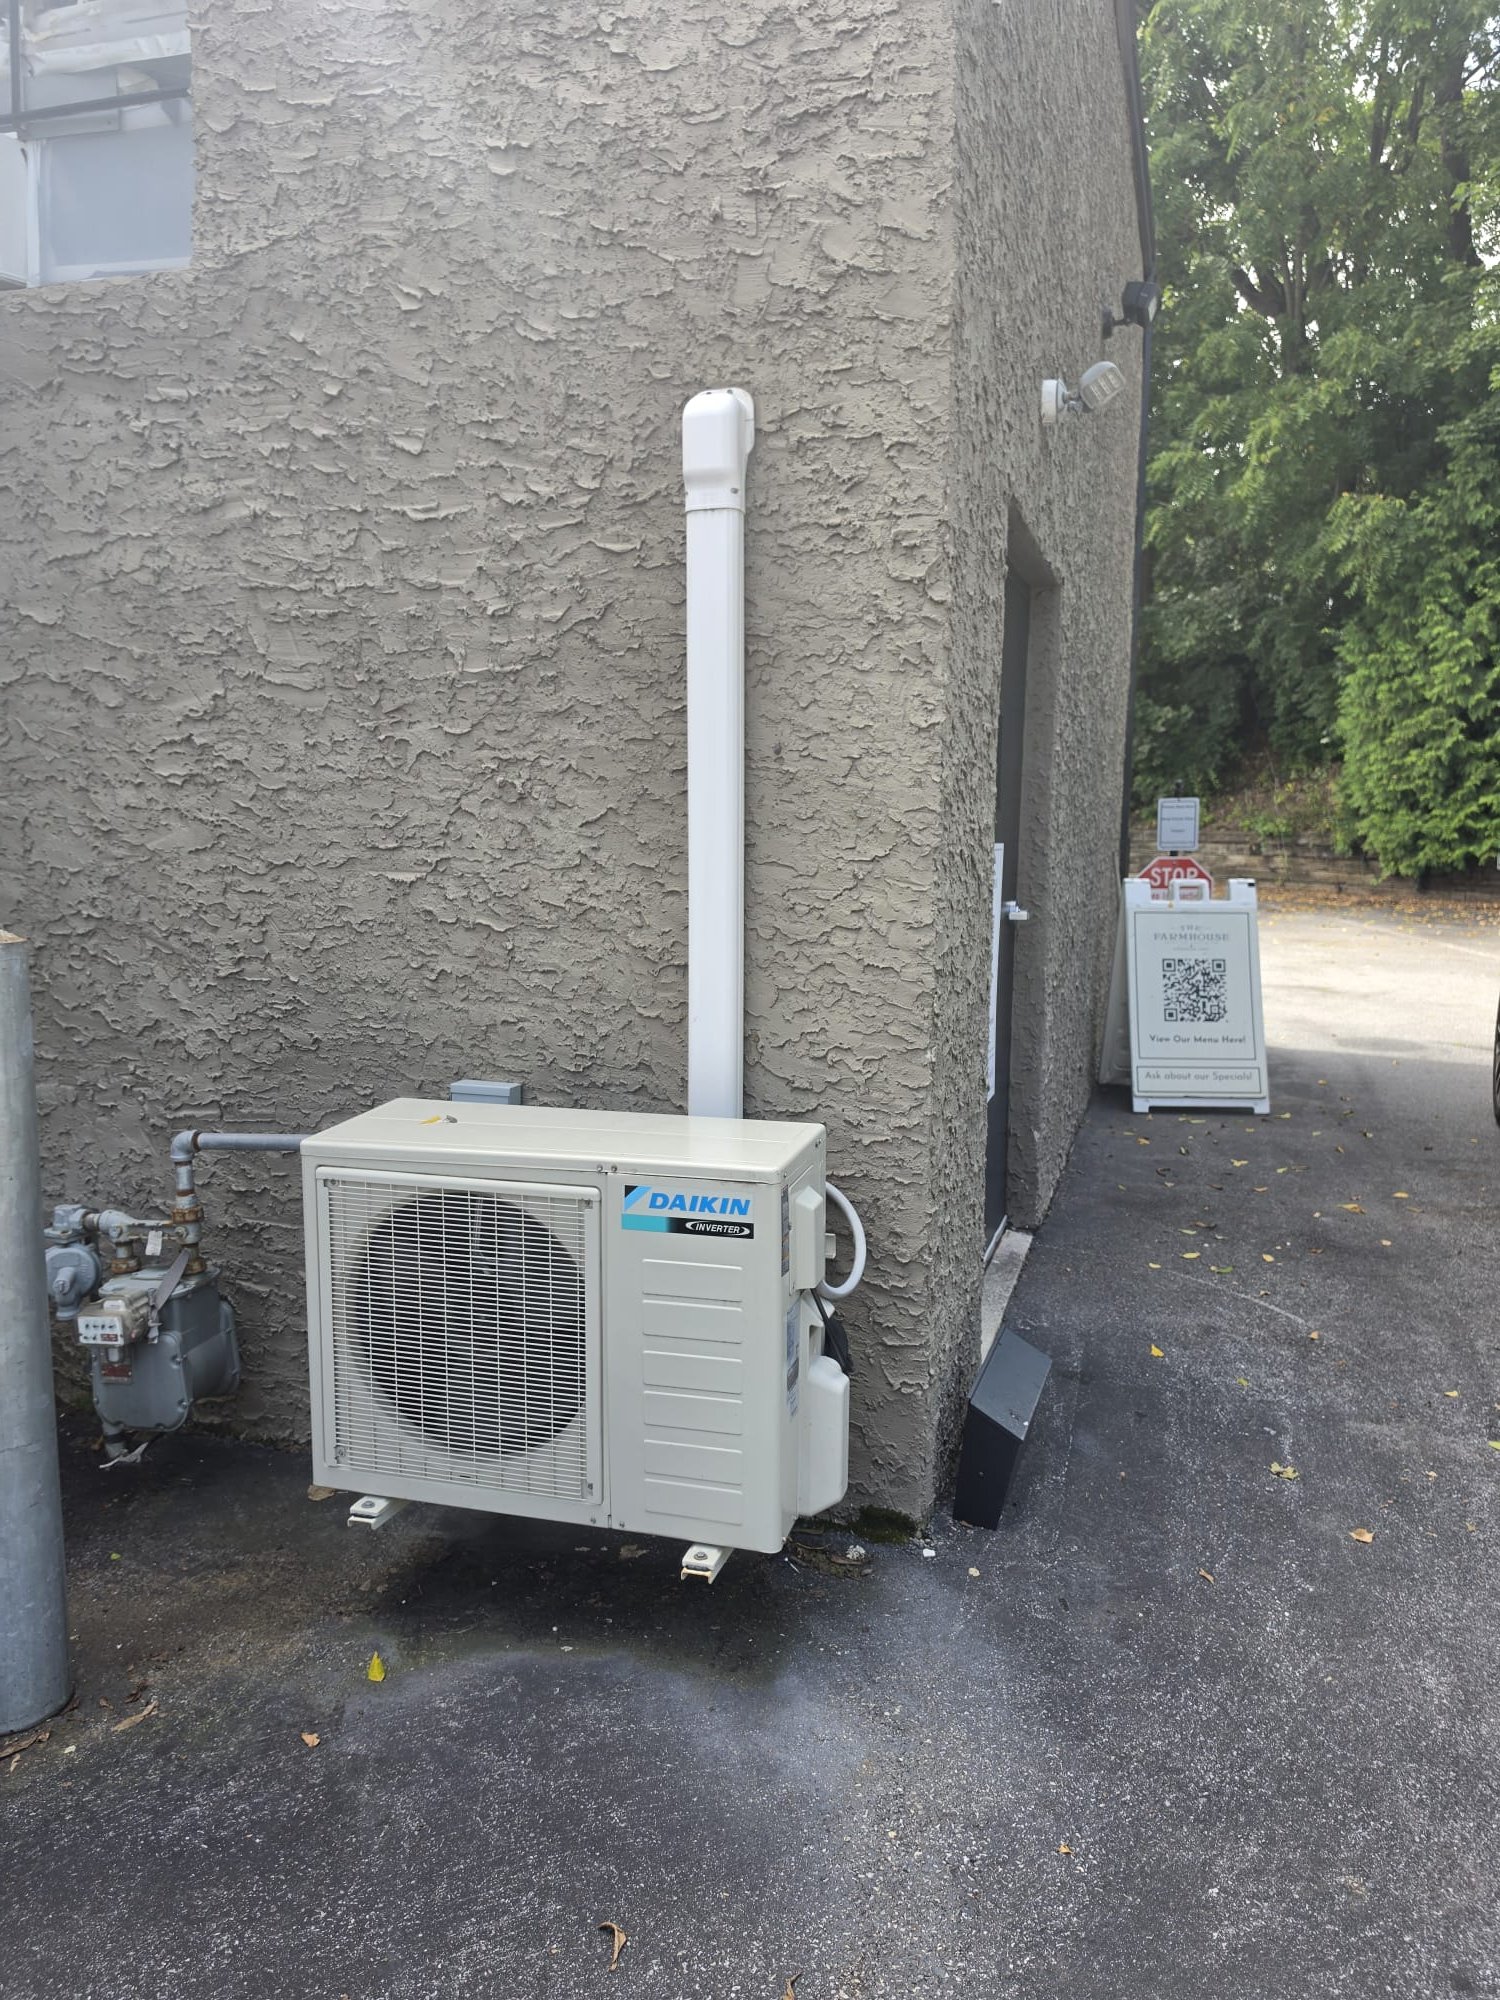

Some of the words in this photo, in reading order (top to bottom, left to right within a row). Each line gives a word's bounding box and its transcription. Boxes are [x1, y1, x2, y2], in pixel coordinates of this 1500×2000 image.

[1151, 867, 1198, 886] STOP
[1153, 932, 1229, 941] FARMHOUSE
[1148, 1033, 1171, 1042] View
[1173, 1034, 1191, 1043] Our
[1193, 1035, 1219, 1043] Menu
[1222, 1035, 1246, 1044] Here!
[1145, 1071, 1162, 1080] Ask
[1164, 1071, 1191, 1081] about
[648, 1192, 751, 1216] DAIKIN
[695, 1222, 741, 1234] INVERTER
